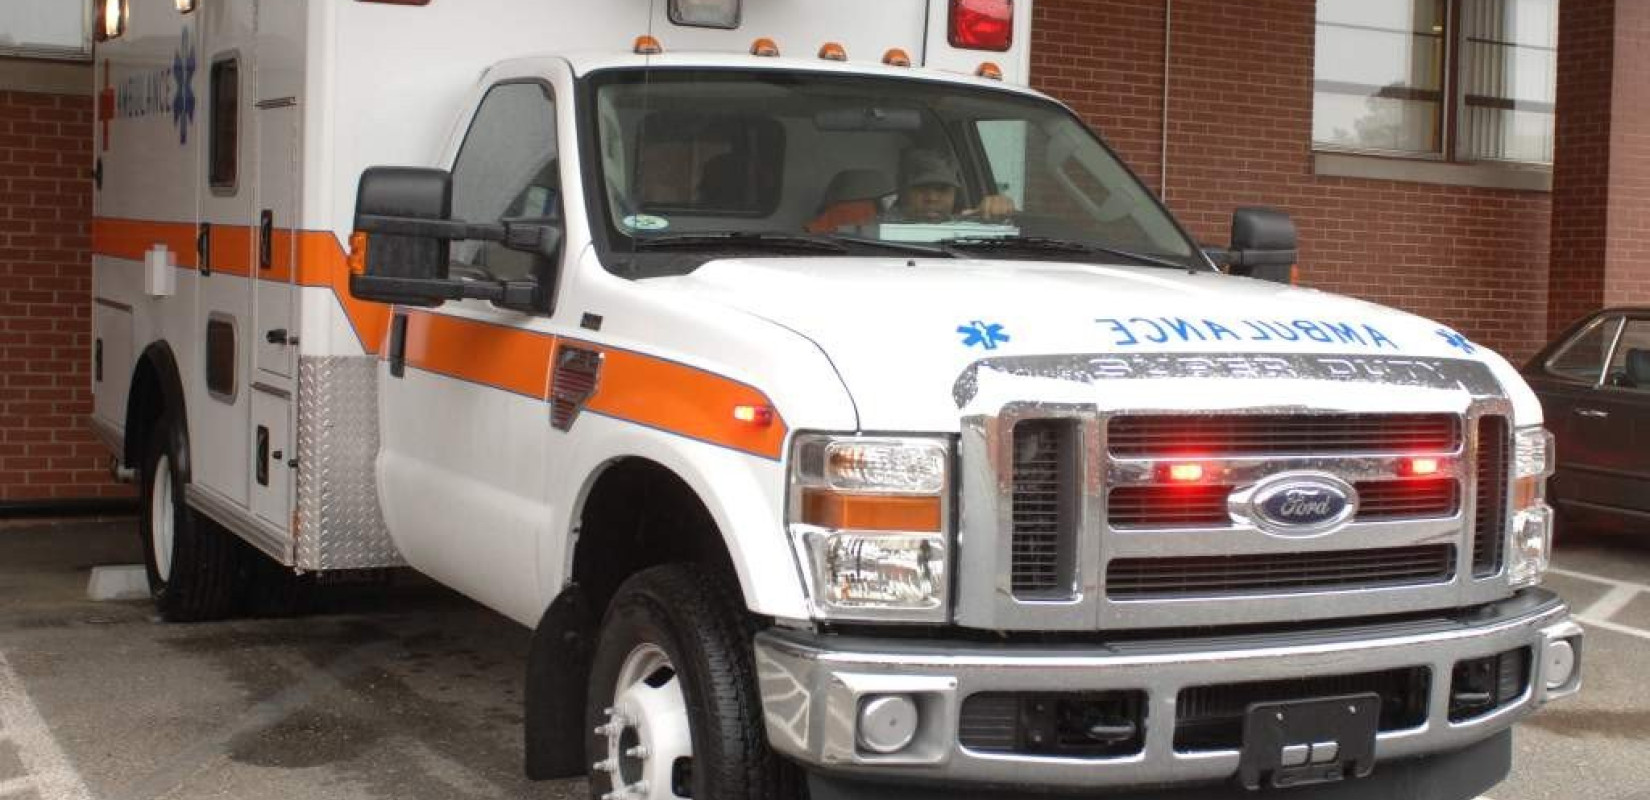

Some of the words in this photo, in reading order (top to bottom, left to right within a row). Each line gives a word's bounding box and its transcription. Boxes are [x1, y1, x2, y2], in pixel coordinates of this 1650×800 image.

[117, 68, 171, 117] AMBULANCE
[1088, 357, 1298, 379] SUPER
[1316, 358, 1446, 383] DUTY
[1280, 489, 1330, 516] Ford
